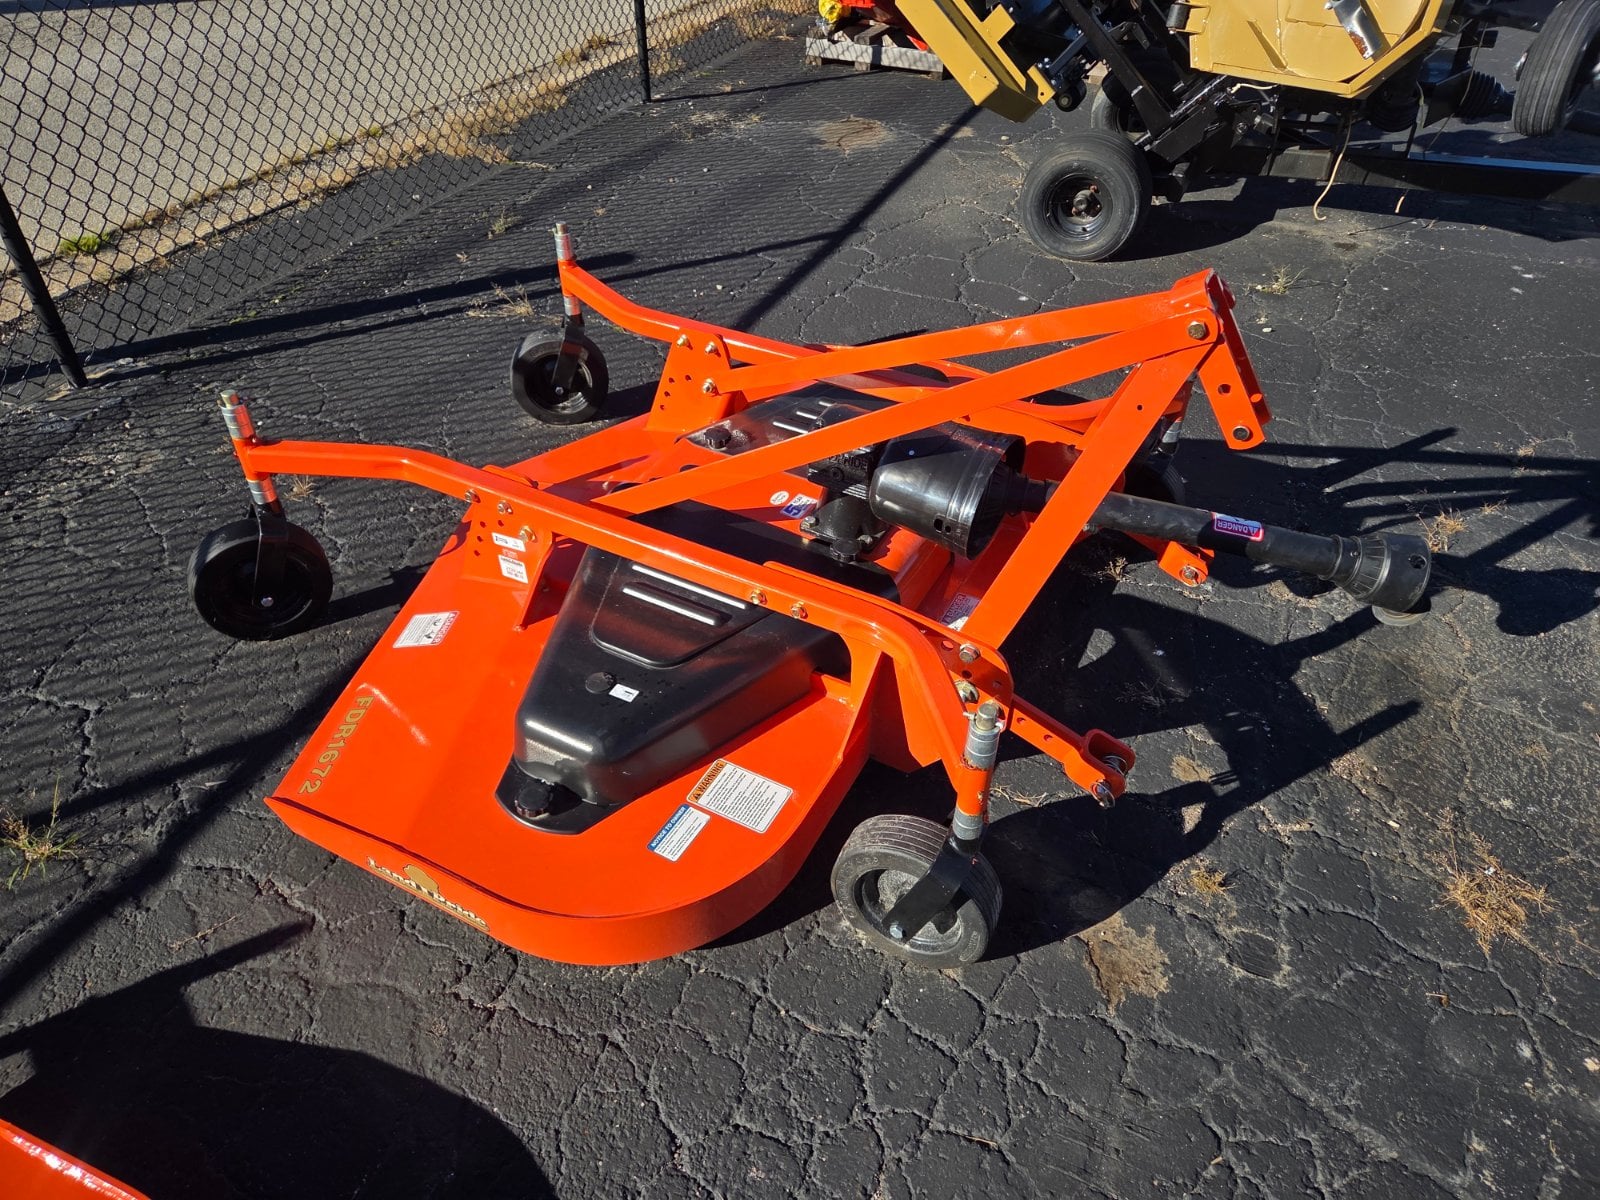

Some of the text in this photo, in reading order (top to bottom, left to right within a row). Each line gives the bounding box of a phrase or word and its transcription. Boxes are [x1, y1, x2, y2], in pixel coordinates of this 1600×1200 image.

[1217, 520, 1249, 534] DANGER
[946, 593, 965, 617] DANGER
[298, 696, 374, 794] FDR1672
[698, 762, 724, 793] WARNING
[650, 829, 668, 848] NOTICE
[670, 806, 687, 824] OWNER
[366, 855, 420, 890] Land
